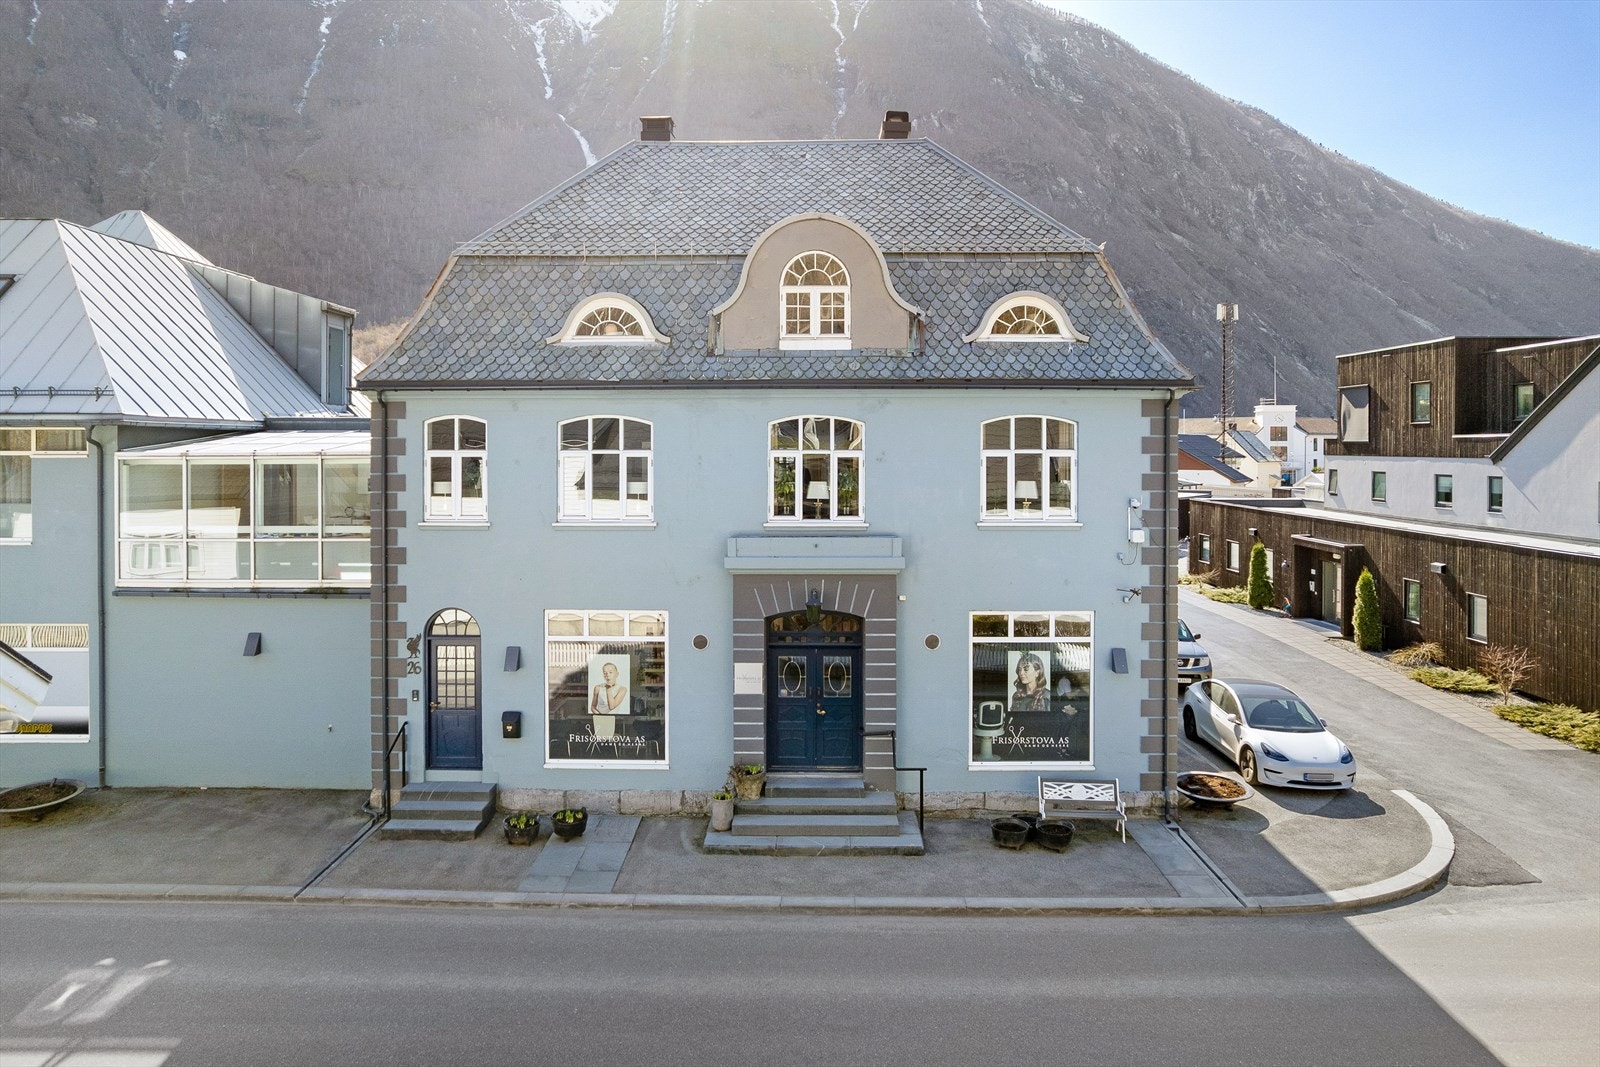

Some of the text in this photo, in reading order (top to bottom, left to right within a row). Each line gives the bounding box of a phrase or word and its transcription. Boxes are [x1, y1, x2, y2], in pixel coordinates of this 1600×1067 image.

[407, 660, 422, 675] 26
[635, 735, 646, 743] AS
[1058, 736, 1070, 745] AS
